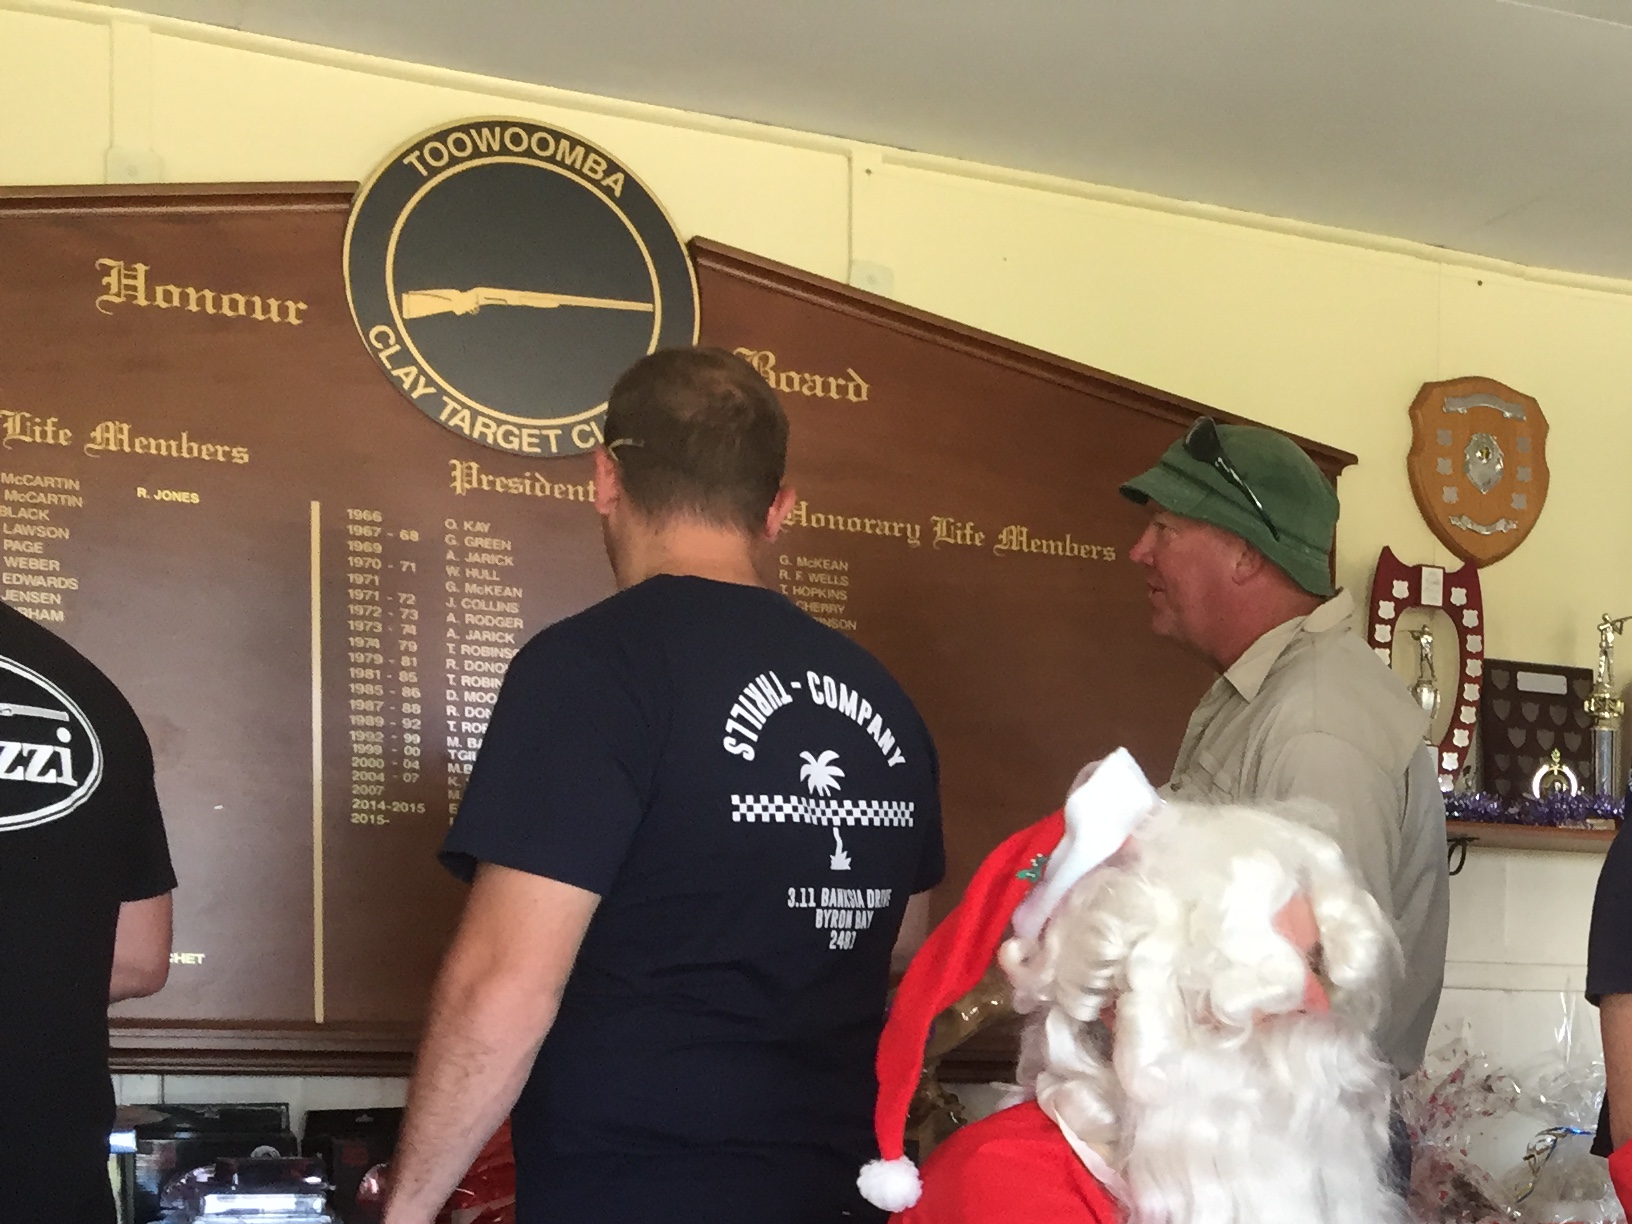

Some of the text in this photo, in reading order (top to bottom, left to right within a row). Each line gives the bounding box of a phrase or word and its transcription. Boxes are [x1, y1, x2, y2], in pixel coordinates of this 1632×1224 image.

[403, 126, 625, 197] TOOWOOMBA
[95, 257, 308, 325] Honour
[734, 346, 870, 402] Board
[368, 324, 437, 400] CLAY
[437, 396, 562, 453] TARGET
[0, 409, 250, 464] Life Members
[0, 472, 80, 491] McCARTIN
[4, 489, 83, 508] McCARTIN
[137, 487, 201, 504] R. JONES
[0, 505, 50, 521] BLACK
[347, 509, 382, 522] 1966
[3, 522, 70, 539] LAWSON
[346, 524, 381, 537] 1967
[463, 521, 491, 533] KAY
[781, 500, 1117, 562] Honorary Life Members
[3, 538, 44, 554] PAGE
[347, 540, 382, 553] 1969
[464, 536, 512, 551] GREEN
[3, 556, 60, 571] WEBER
[347, 556, 382, 570] 1970
[400, 560, 416, 573] 71
[464, 552, 514, 566] JARICK
[779, 555, 849, 571] G. McKEAN
[2, 572, 79, 590] EDWARDS
[347, 573, 379, 586] 1971
[465, 568, 500, 581] HULL
[779, 569, 791, 580] R.
[808, 572, 849, 587] WELLS
[1, 588, 62, 604] JENSEN
[347, 589, 379, 601] 1971
[398, 592, 416, 605] 72
[445, 581, 523, 598] G. McKEAN
[792, 585, 848, 600] HOPKINS
[347, 604, 382, 617] 1972
[399, 607, 419, 620] 73
[445, 597, 520, 614] J. COLLINS
[347, 620, 383, 633] 1973
[446, 612, 524, 629] A. RODGER
[446, 628, 515, 644] A. JARICK
[446, 643, 456, 654] T.
[348, 652, 383, 665] 1979
[401, 656, 418, 667] 81
[445, 658, 459, 670] R.
[399, 670, 418, 682] 85
[446, 674, 456, 685] T.
[401, 686, 421, 698] 86
[446, 689, 459, 701] D.
[402, 702, 421, 714] 88
[446, 705, 460, 717] R.
[402, 718, 421, 729] 92
[446, 720, 457, 732] T.
[723, 670, 793, 761] THRILLS
[806, 670, 906, 767] COMPANY
[403, 732, 421, 744] 99
[446, 736, 462, 747] M.
[404, 745, 421, 757] 00
[351, 757, 384, 769] 2000
[403, 758, 420, 770] 04
[351, 770, 385, 782] 2004
[403, 772, 419, 783] 07
[351, 784, 384, 795] 2007
[352, 798, 426, 814] 2014-2015
[787, 887, 816, 908] 3.11
[821, 887, 865, 909] BANKSIA
[815, 908, 874, 930] BYRON BAY
[169, 952, 206, 965] HET
